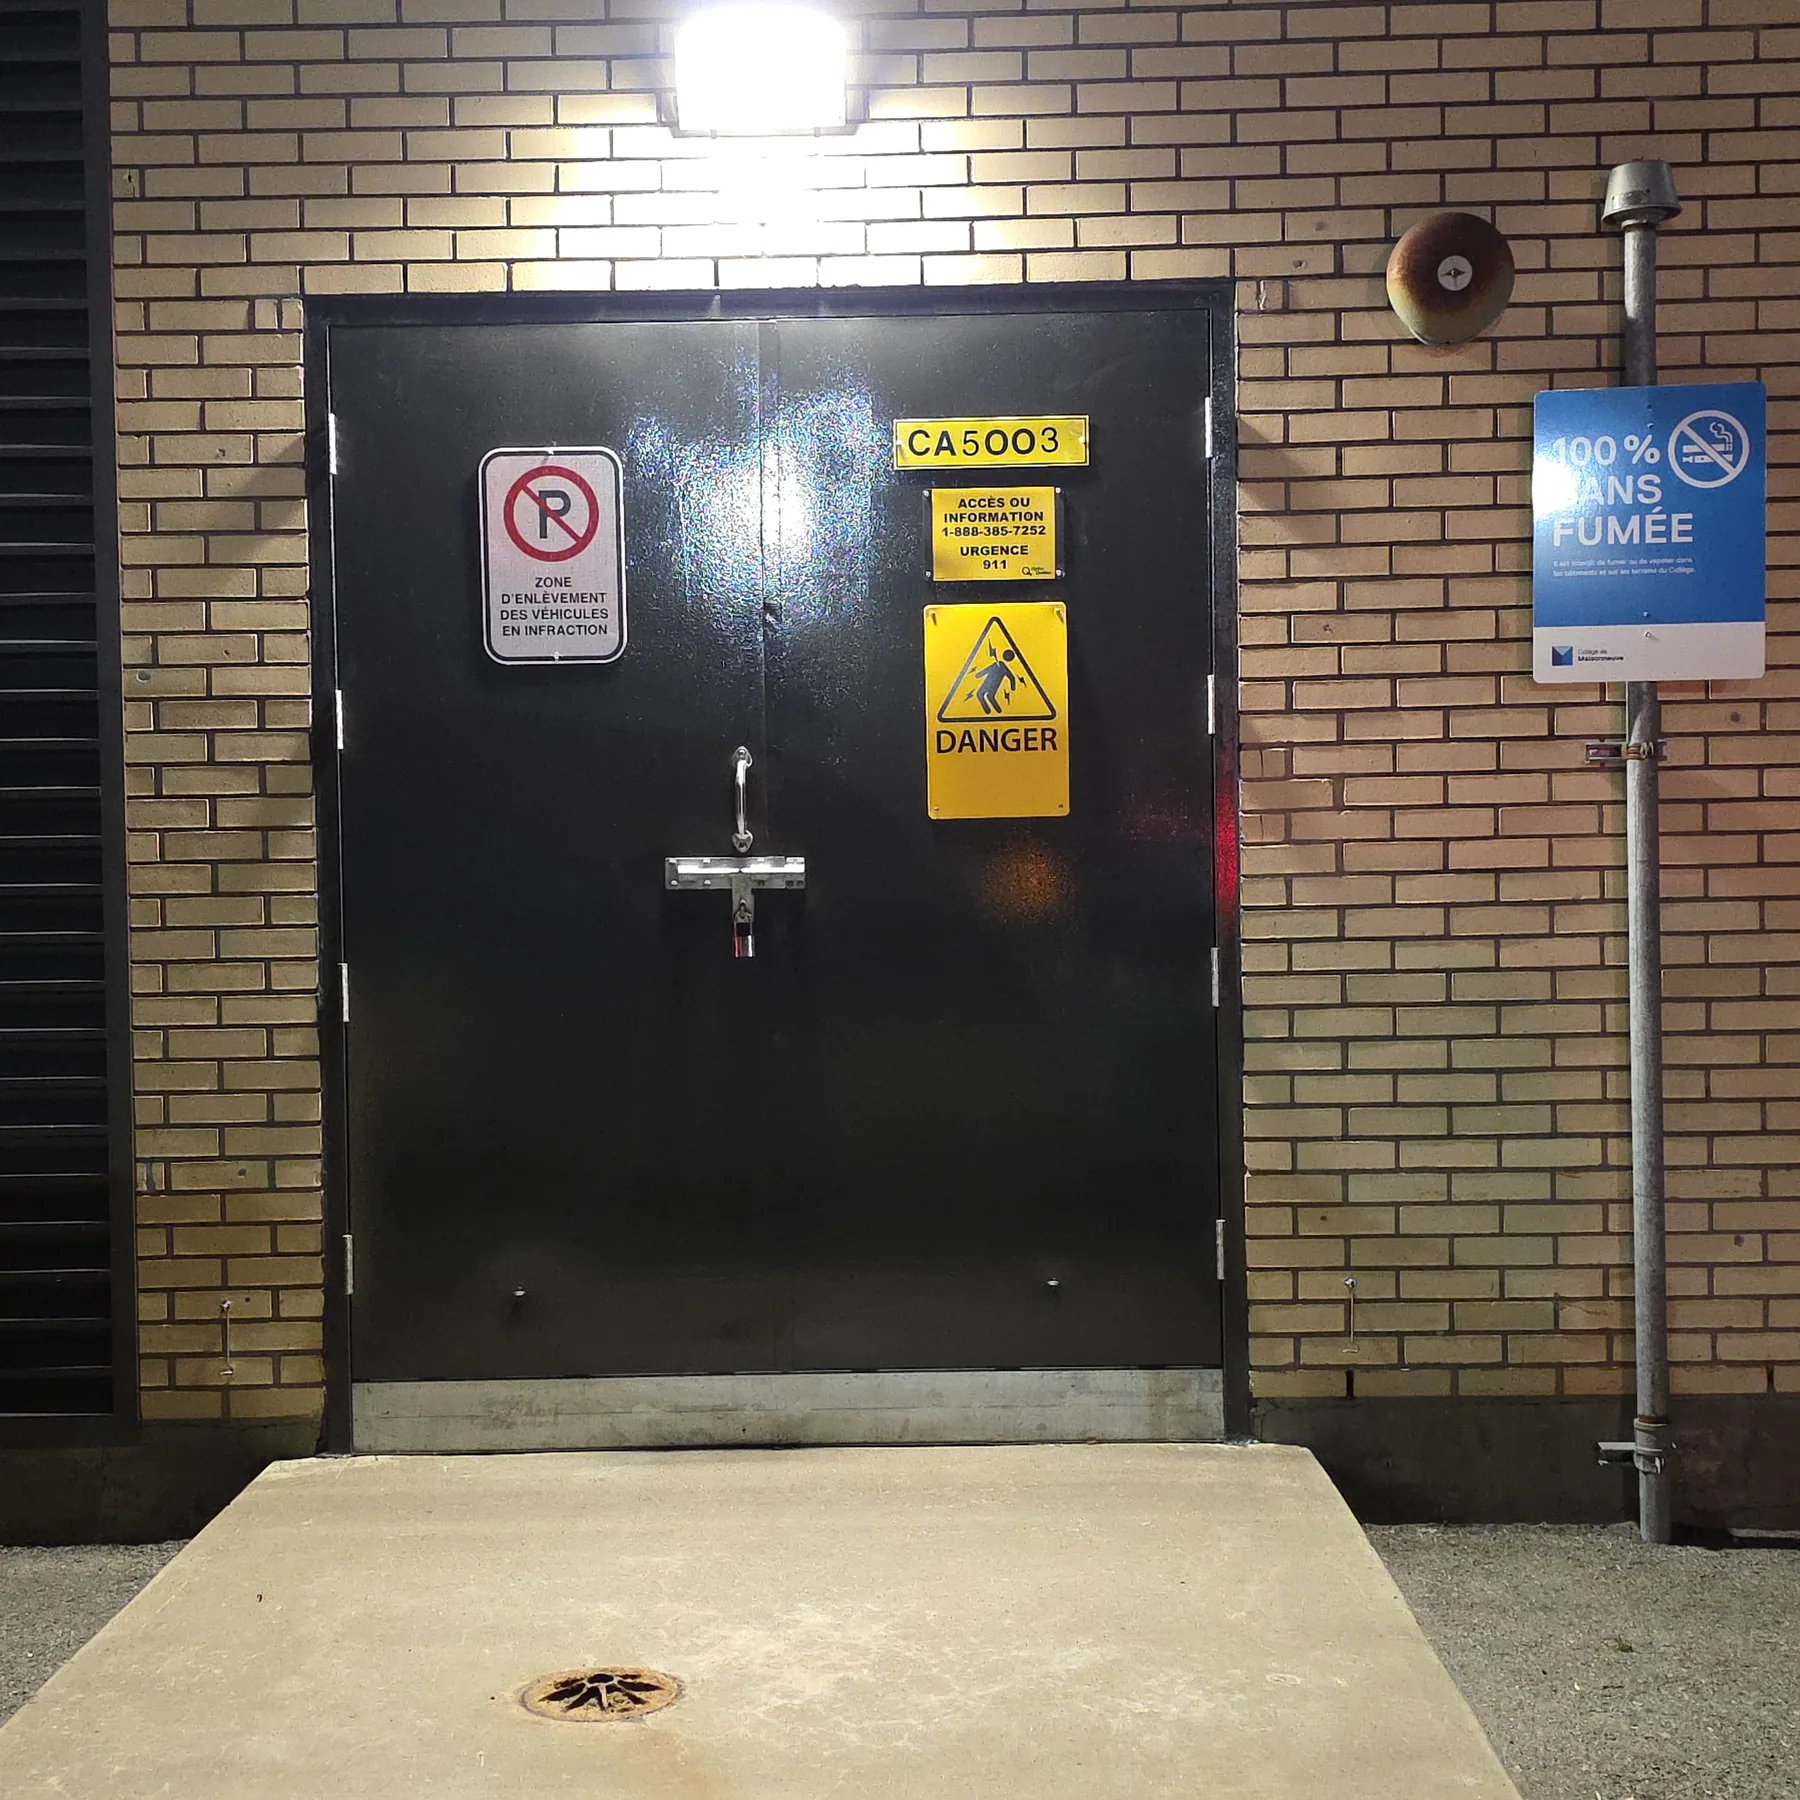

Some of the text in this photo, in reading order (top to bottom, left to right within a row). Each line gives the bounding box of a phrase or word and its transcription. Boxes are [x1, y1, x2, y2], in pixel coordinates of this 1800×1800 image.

[908, 427, 1059, 457] CA5003
[1553, 434, 1660, 466] 100 %
[1557, 474, 1662, 505] ANS
[957, 496, 1030, 509] ACCÈS OU
[944, 511, 1044, 523] INFORMATION
[941, 525, 1046, 538] 1-888-385-7252
[1553, 506, 1693, 547] FUMÉE
[960, 545, 1029, 557] URGENCE
[983, 559, 1007, 570] 911
[535, 577, 572, 588] ZONE
[501, 590, 607, 605] D'ENLÈVEMENT
[500, 607, 609, 621] DES VÉHICULES
[502, 624, 608, 636] EN INFRACTION
[936, 728, 1058, 753] DANGER
